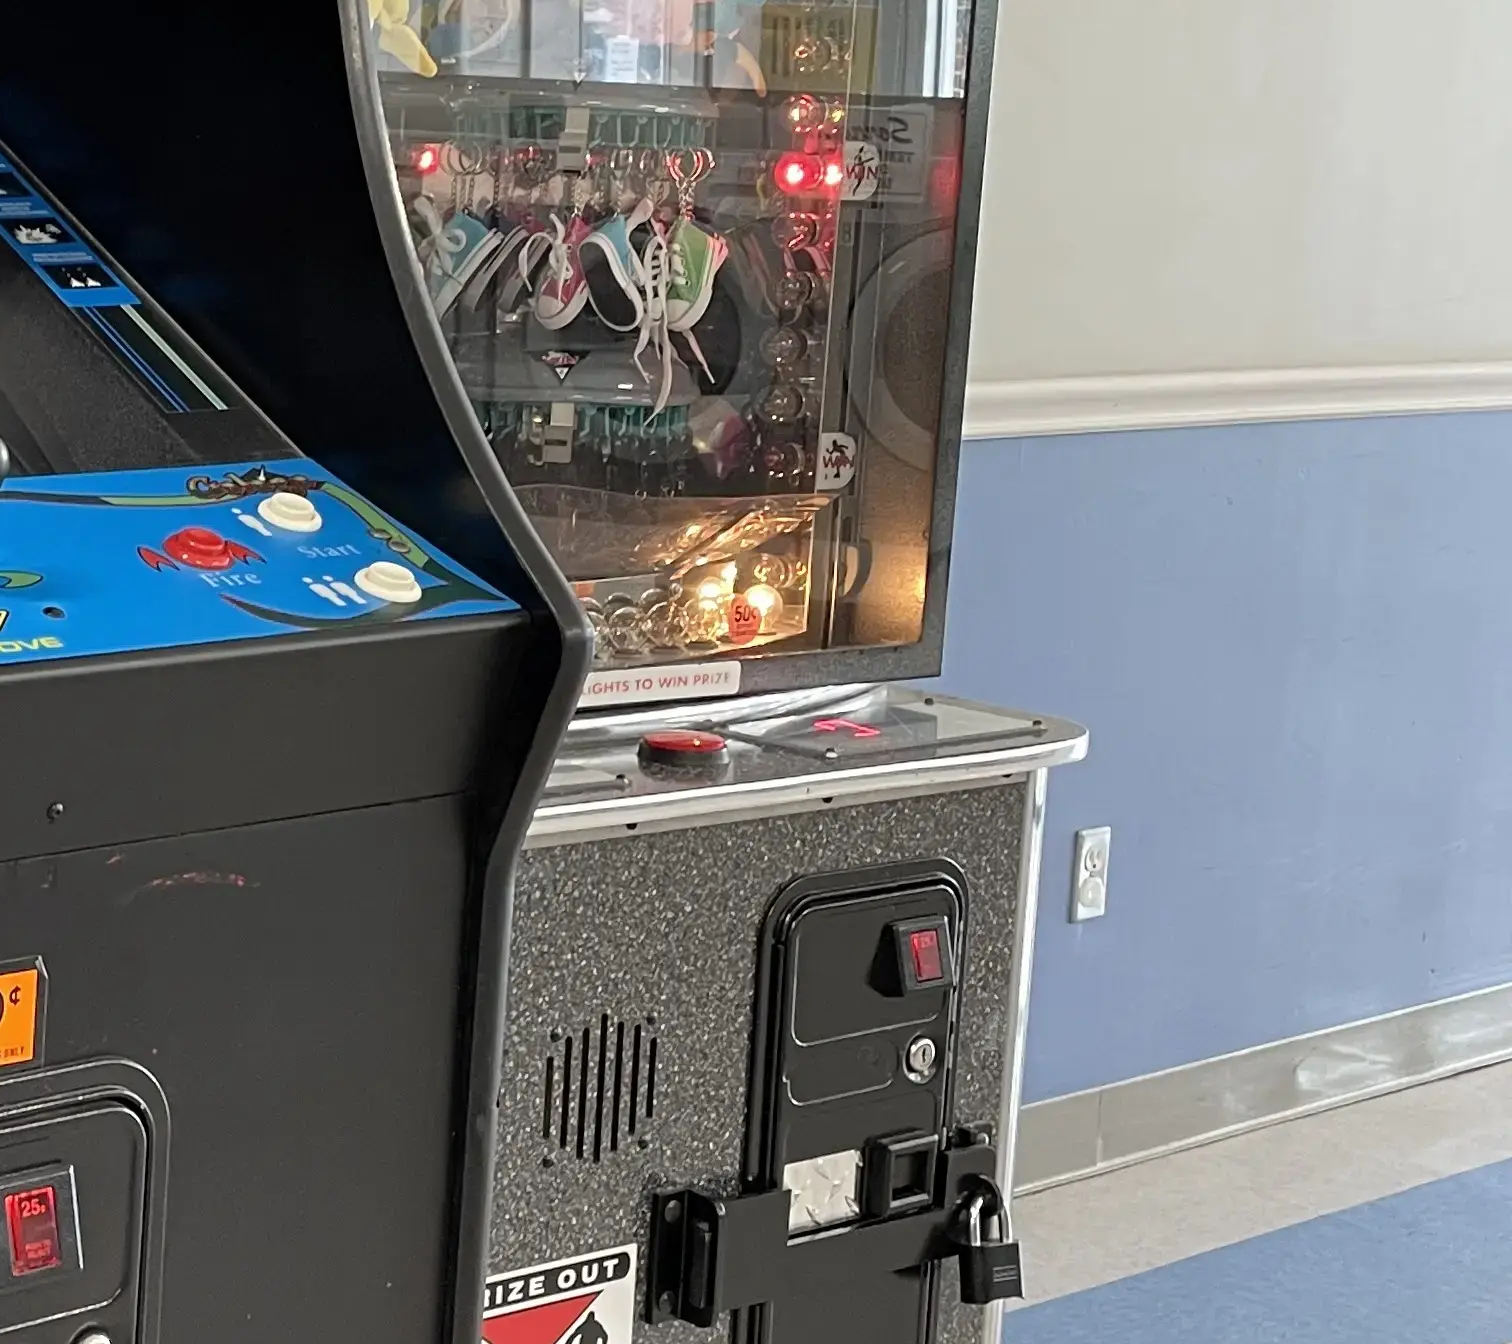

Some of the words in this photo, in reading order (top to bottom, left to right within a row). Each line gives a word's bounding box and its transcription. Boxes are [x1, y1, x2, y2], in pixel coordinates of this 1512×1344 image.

[297, 543, 361, 559] Start
[198, 570, 263, 589] Fire
[582, 678, 630, 696] IGHTS
[635, 678, 653, 692] TO
[659, 674, 688, 689] WIN
[557, 1257, 620, 1290] OUT
